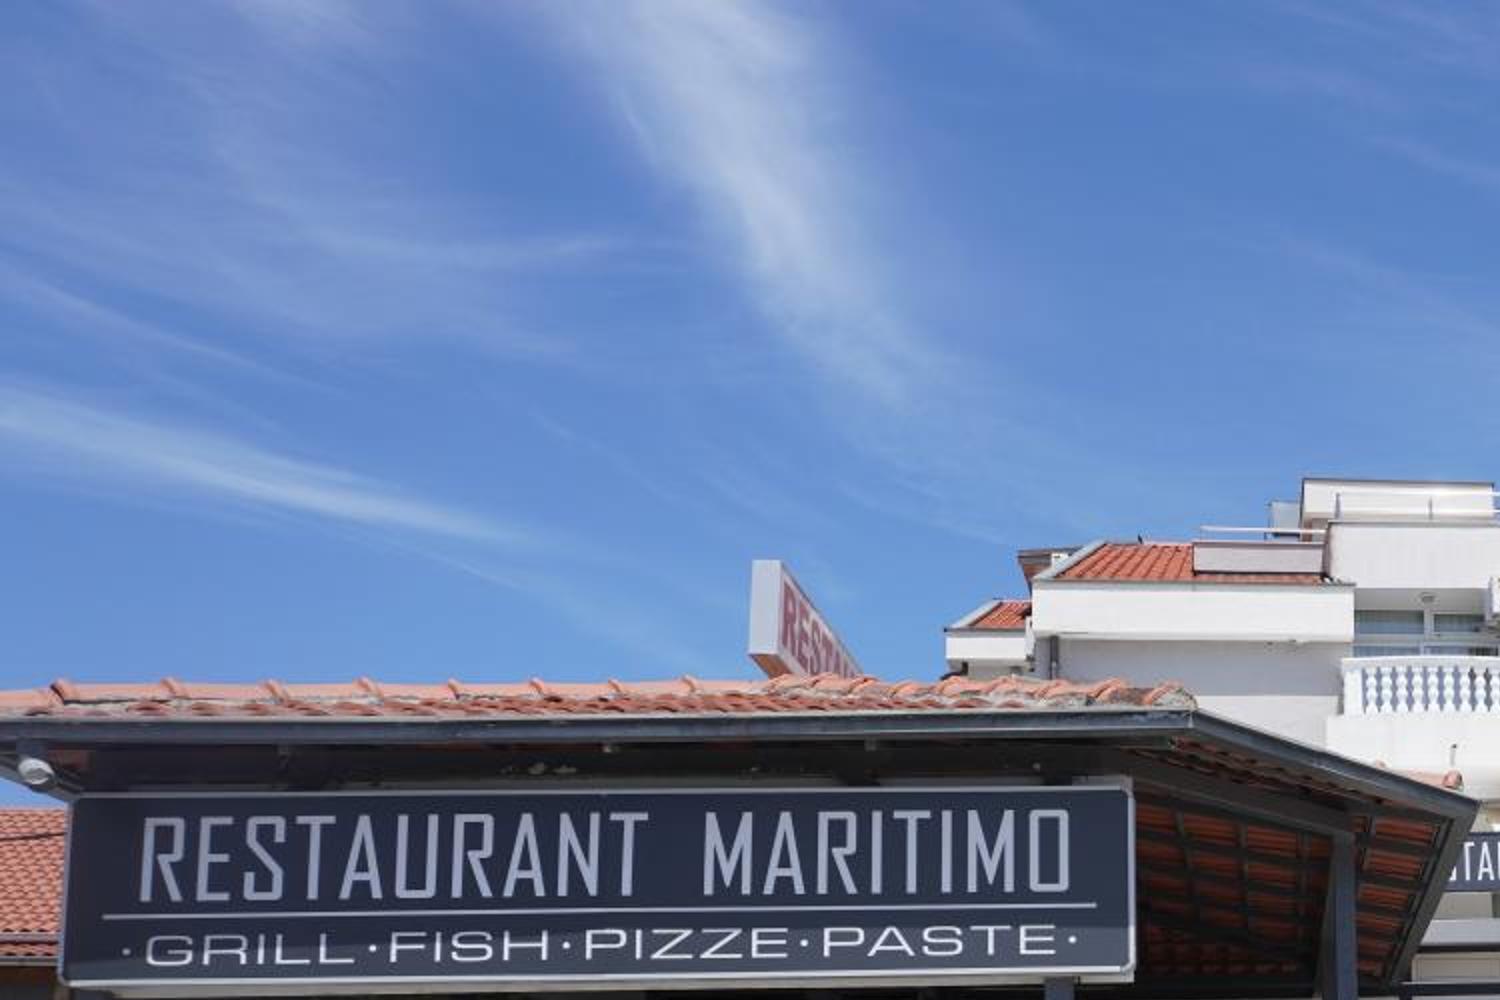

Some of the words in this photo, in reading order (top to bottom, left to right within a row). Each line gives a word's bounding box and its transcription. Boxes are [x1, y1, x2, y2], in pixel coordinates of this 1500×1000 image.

[140, 812, 649, 902] RESTAURANT
[703, 809, 1070, 896] MARITIMO
[146, 934, 355, 966] GRILL
[389, 930, 549, 963] FISH
[585, 927, 788, 961] PIZZE
[823, 924, 1057, 957] PASTE
